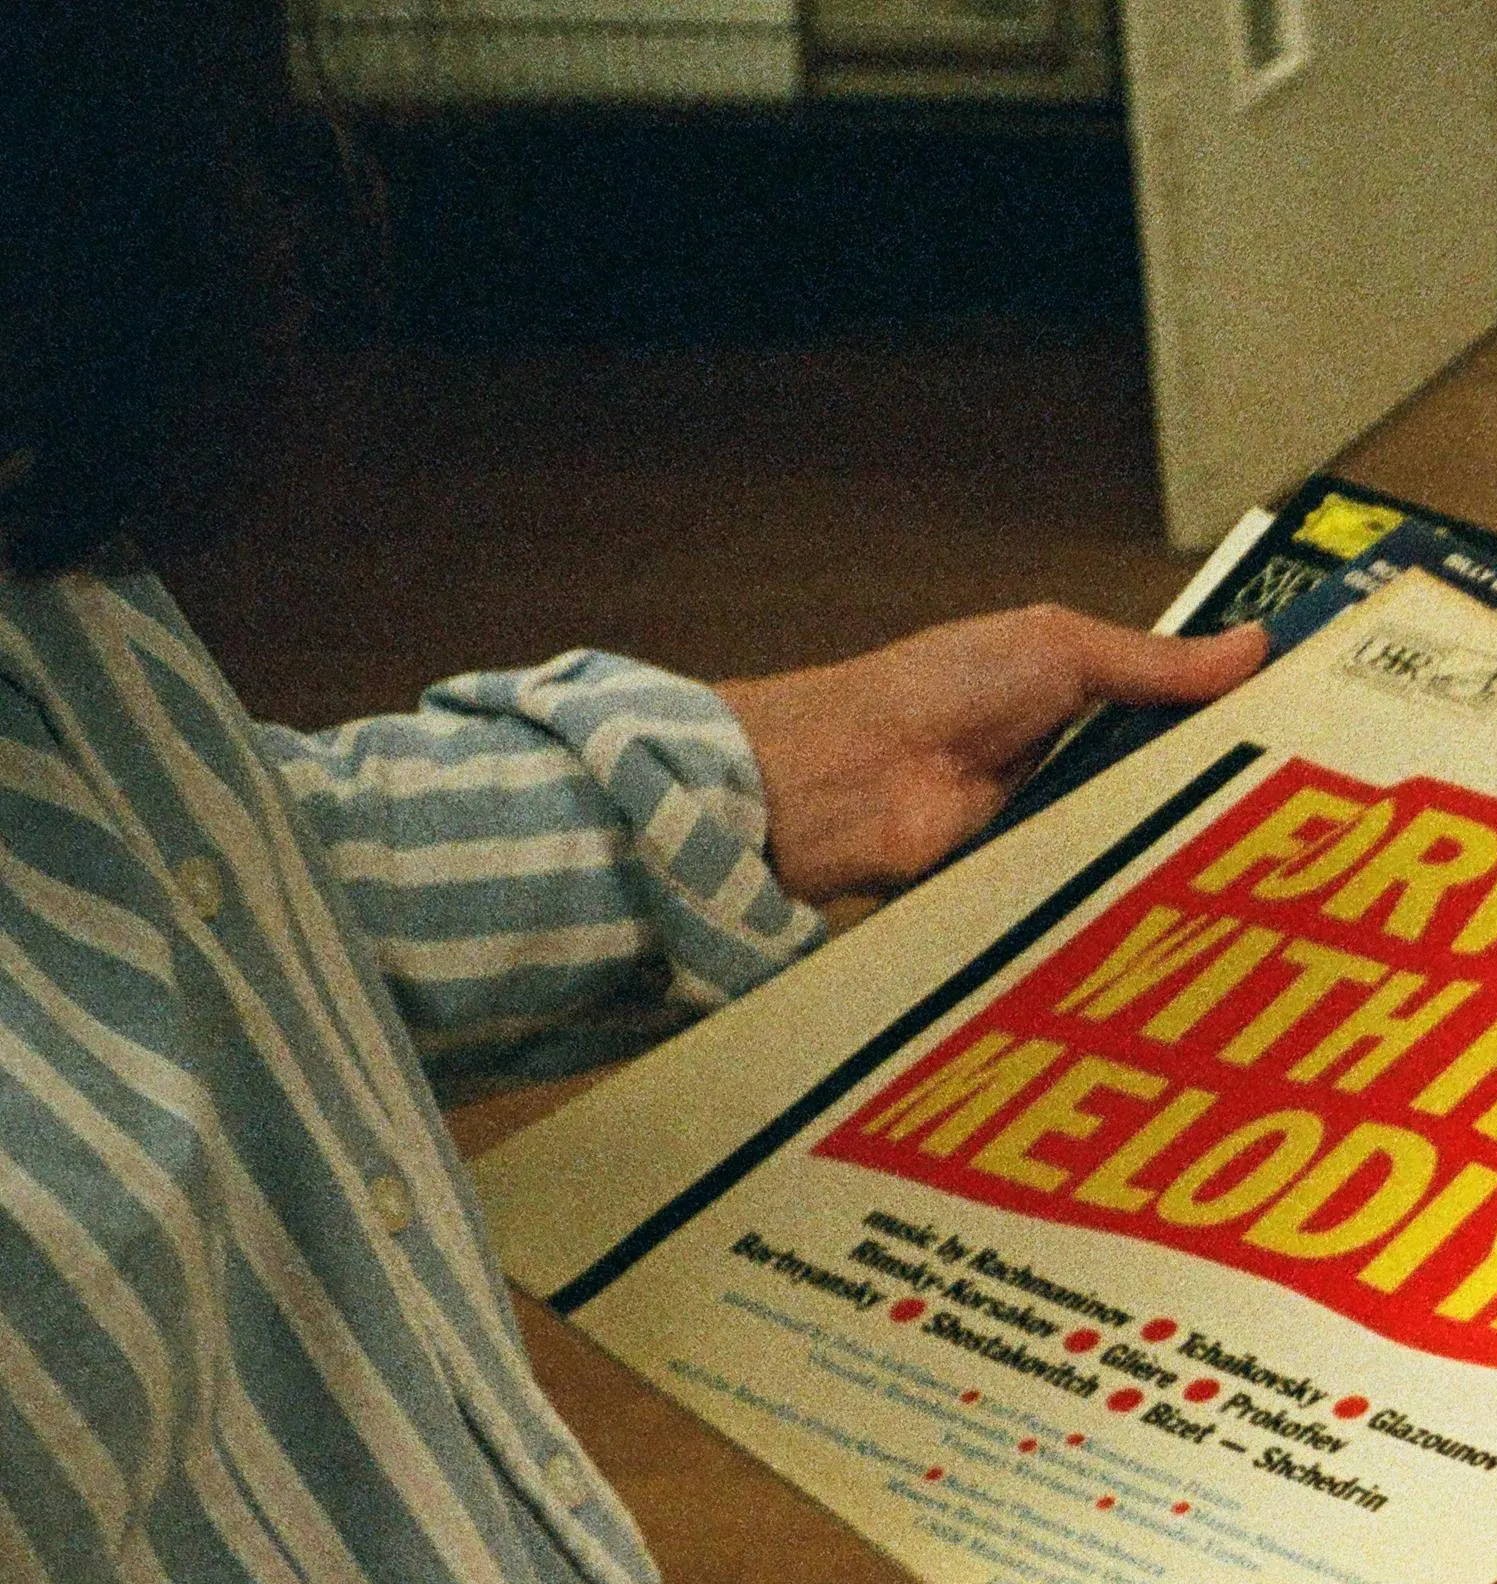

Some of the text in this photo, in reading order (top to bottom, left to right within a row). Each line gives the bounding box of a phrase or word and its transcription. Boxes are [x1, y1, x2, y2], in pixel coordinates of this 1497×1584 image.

[1056, 904, 1478, 1094] WITH
[848, 1239, 1062, 1339] Rimsky-Korsakov
[1219, 1391, 1349, 1455] Prokofiev
[862, 1210, 938, 1249] music
[935, 1235, 968, 1265] by
[967, 1246, 1134, 1328] Rachmaninov
[1176, 1331, 1330, 1409] Tchaikovsky
[921, 1311, 1101, 1400] Shostakovitch
[1140, 1400, 1218, 1445] Bizet
[1252, 1445, 1391, 1514] Shchedrin
